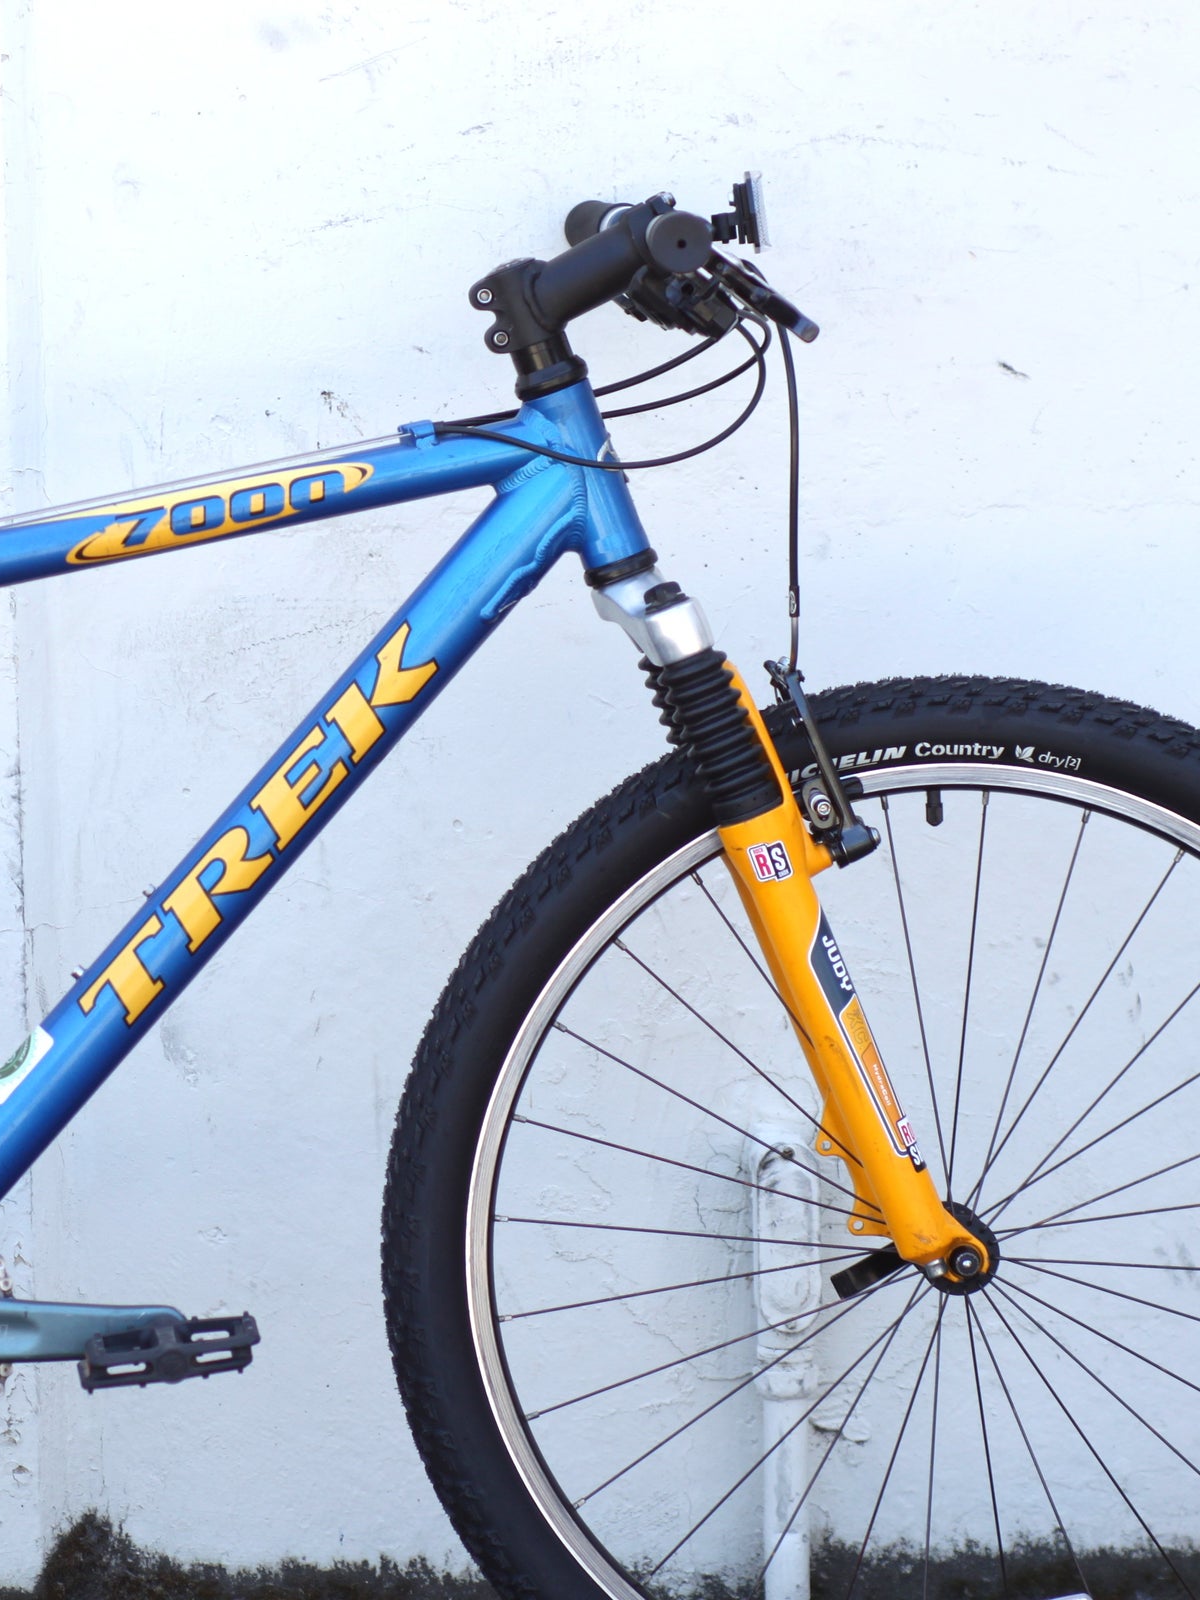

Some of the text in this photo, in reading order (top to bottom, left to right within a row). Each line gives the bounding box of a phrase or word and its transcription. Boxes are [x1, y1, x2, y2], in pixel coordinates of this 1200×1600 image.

[115, 470, 345, 547] 7000
[785, 746, 907, 783] ICELIN
[915, 741, 1005, 759] Country
[79, 620, 438, 1027] TREK
[821, 935, 853, 992] JUDY
